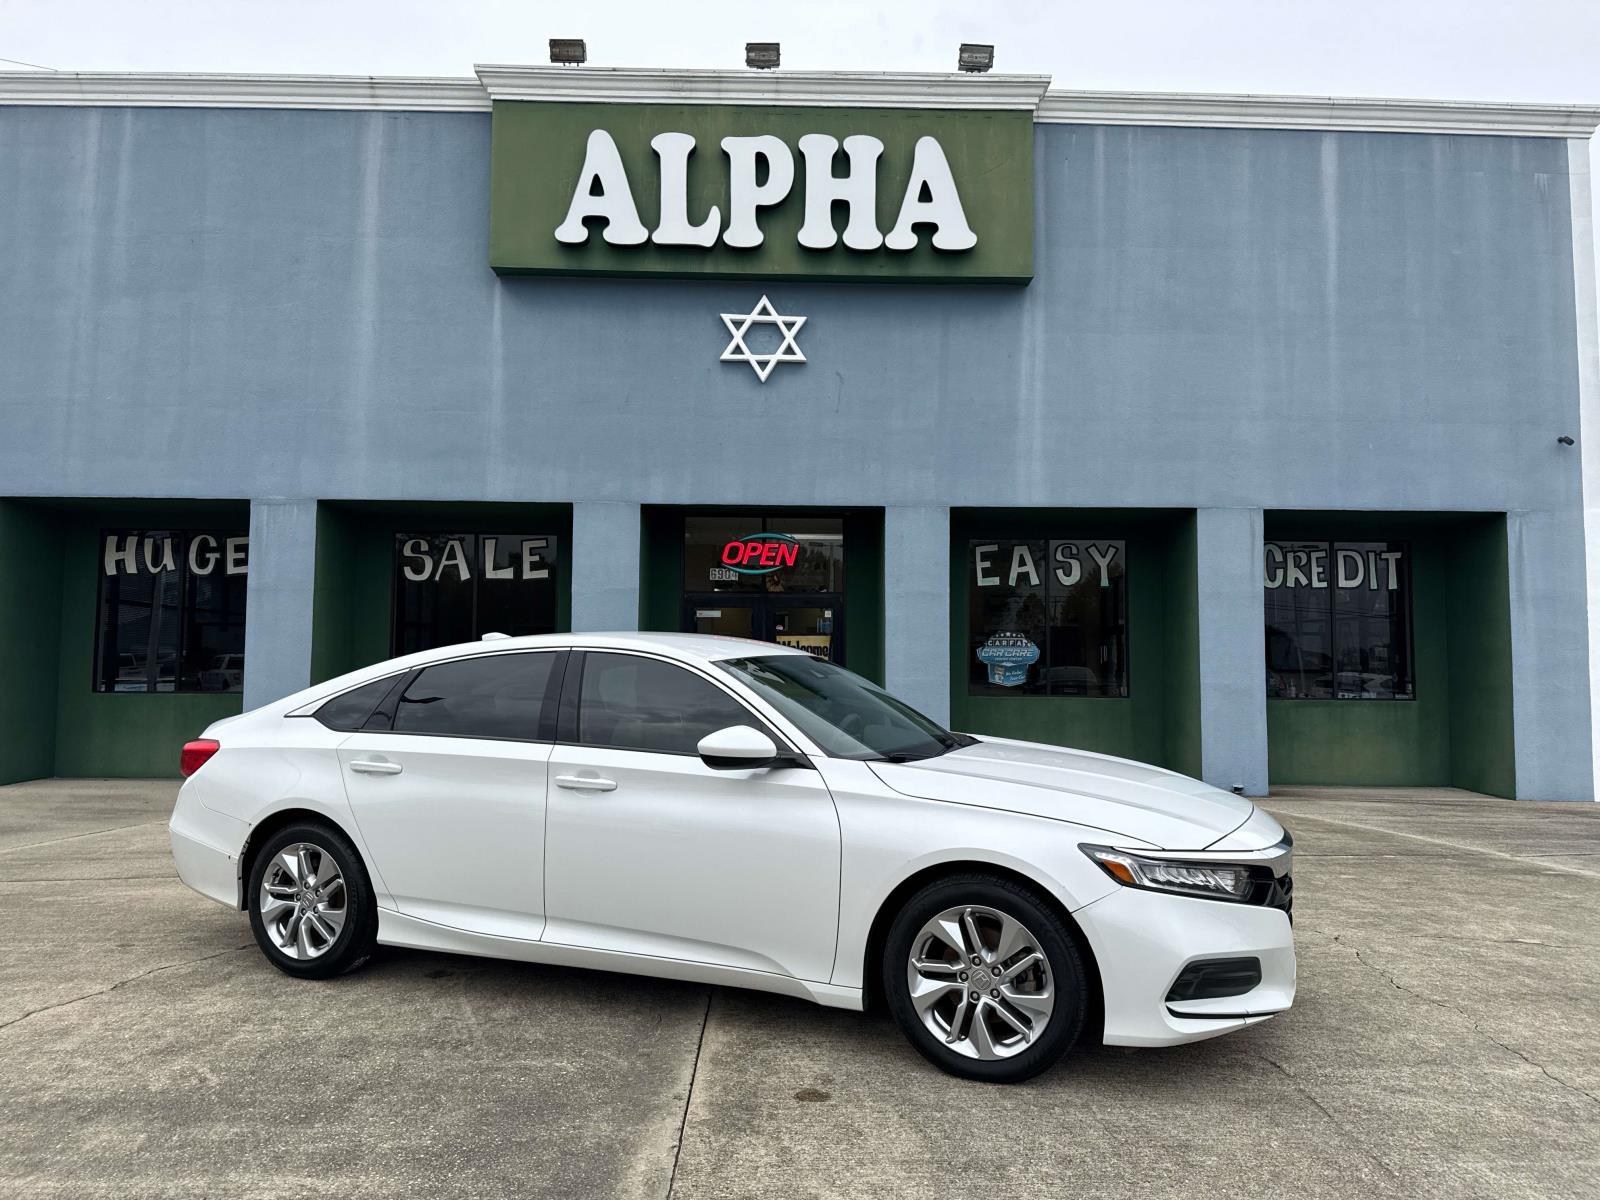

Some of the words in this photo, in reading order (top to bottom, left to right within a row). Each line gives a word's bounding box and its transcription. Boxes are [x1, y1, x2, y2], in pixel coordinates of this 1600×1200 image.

[554, 128, 978, 251] ALPHA
[104, 534, 249, 577] HUGE
[402, 537, 550, 582] SALE
[710, 568, 738, 580] 6904
[721, 541, 800, 567] OPEN
[975, 542, 1120, 588] EASY
[1264, 542, 1403, 591] CREDIT
[982, 648, 1004, 657] CAR
[1004, 648, 1034, 657] CARE
